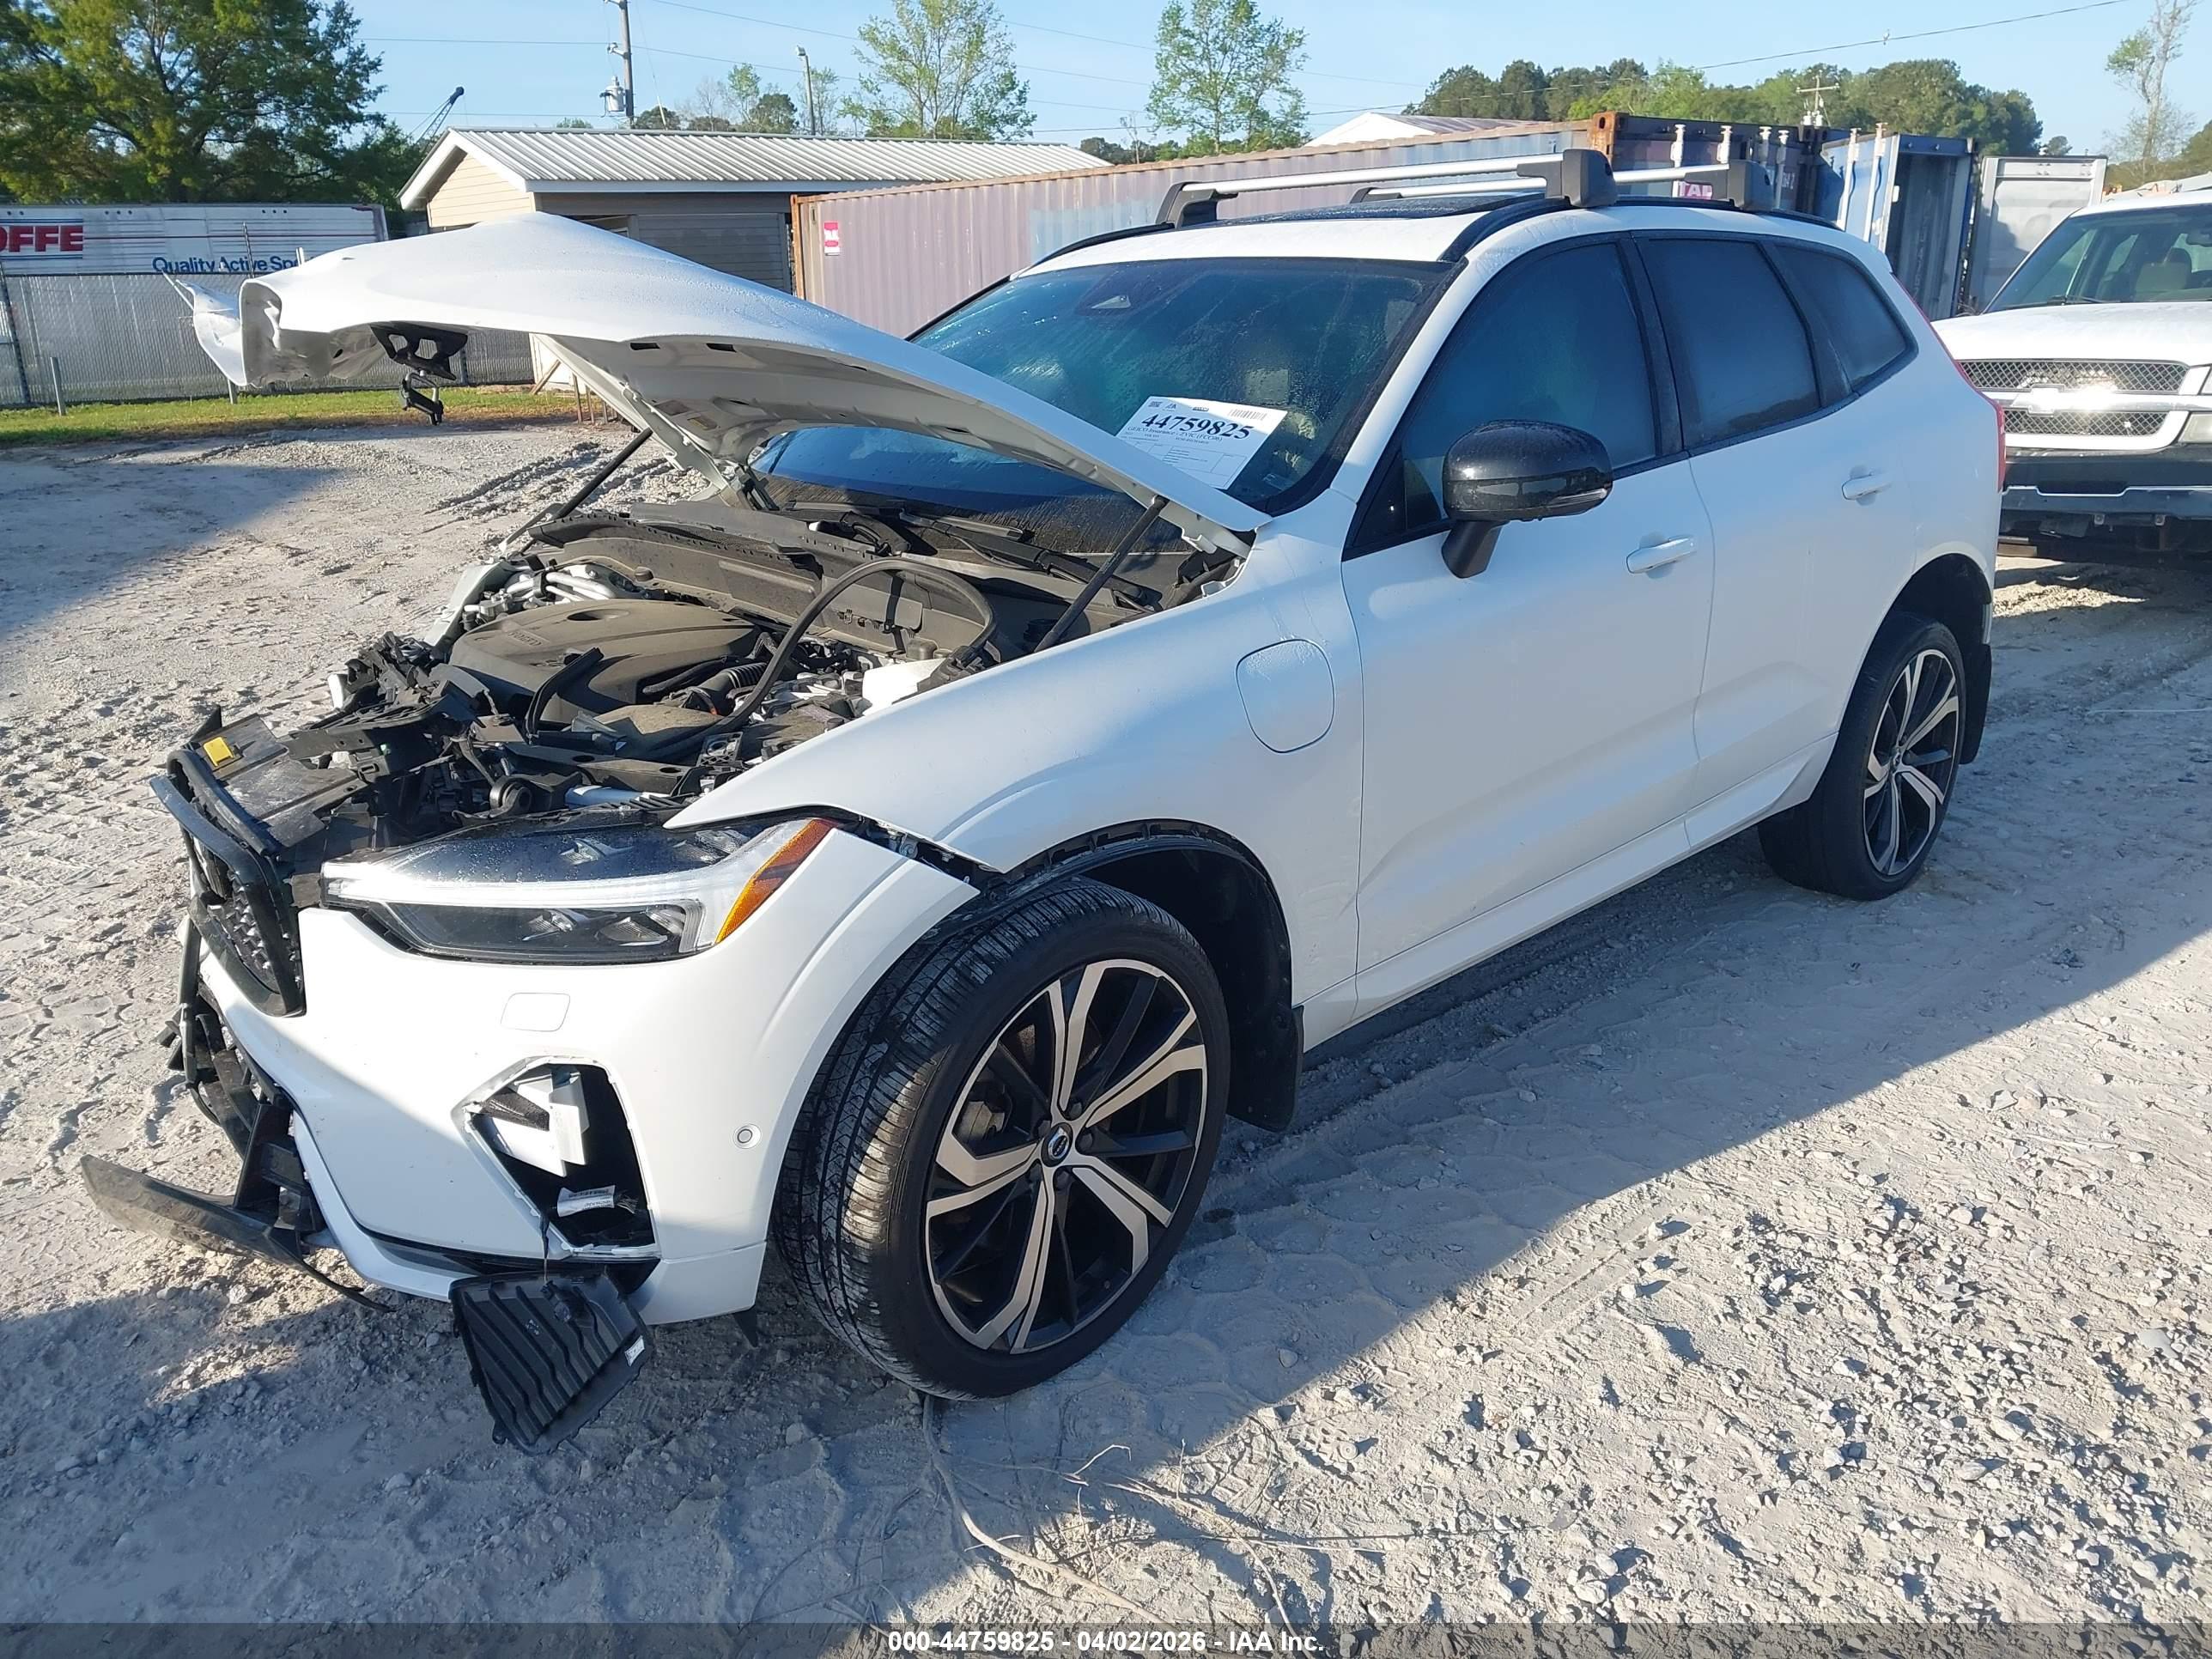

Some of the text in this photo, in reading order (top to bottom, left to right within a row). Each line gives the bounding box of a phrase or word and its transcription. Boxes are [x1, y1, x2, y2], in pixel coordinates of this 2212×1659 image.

[0, 225, 83, 252] FFE
[152, 257, 215, 274] Quality
[218, 255, 271, 272] Active
[1141, 414, 1255, 439] 44759825
